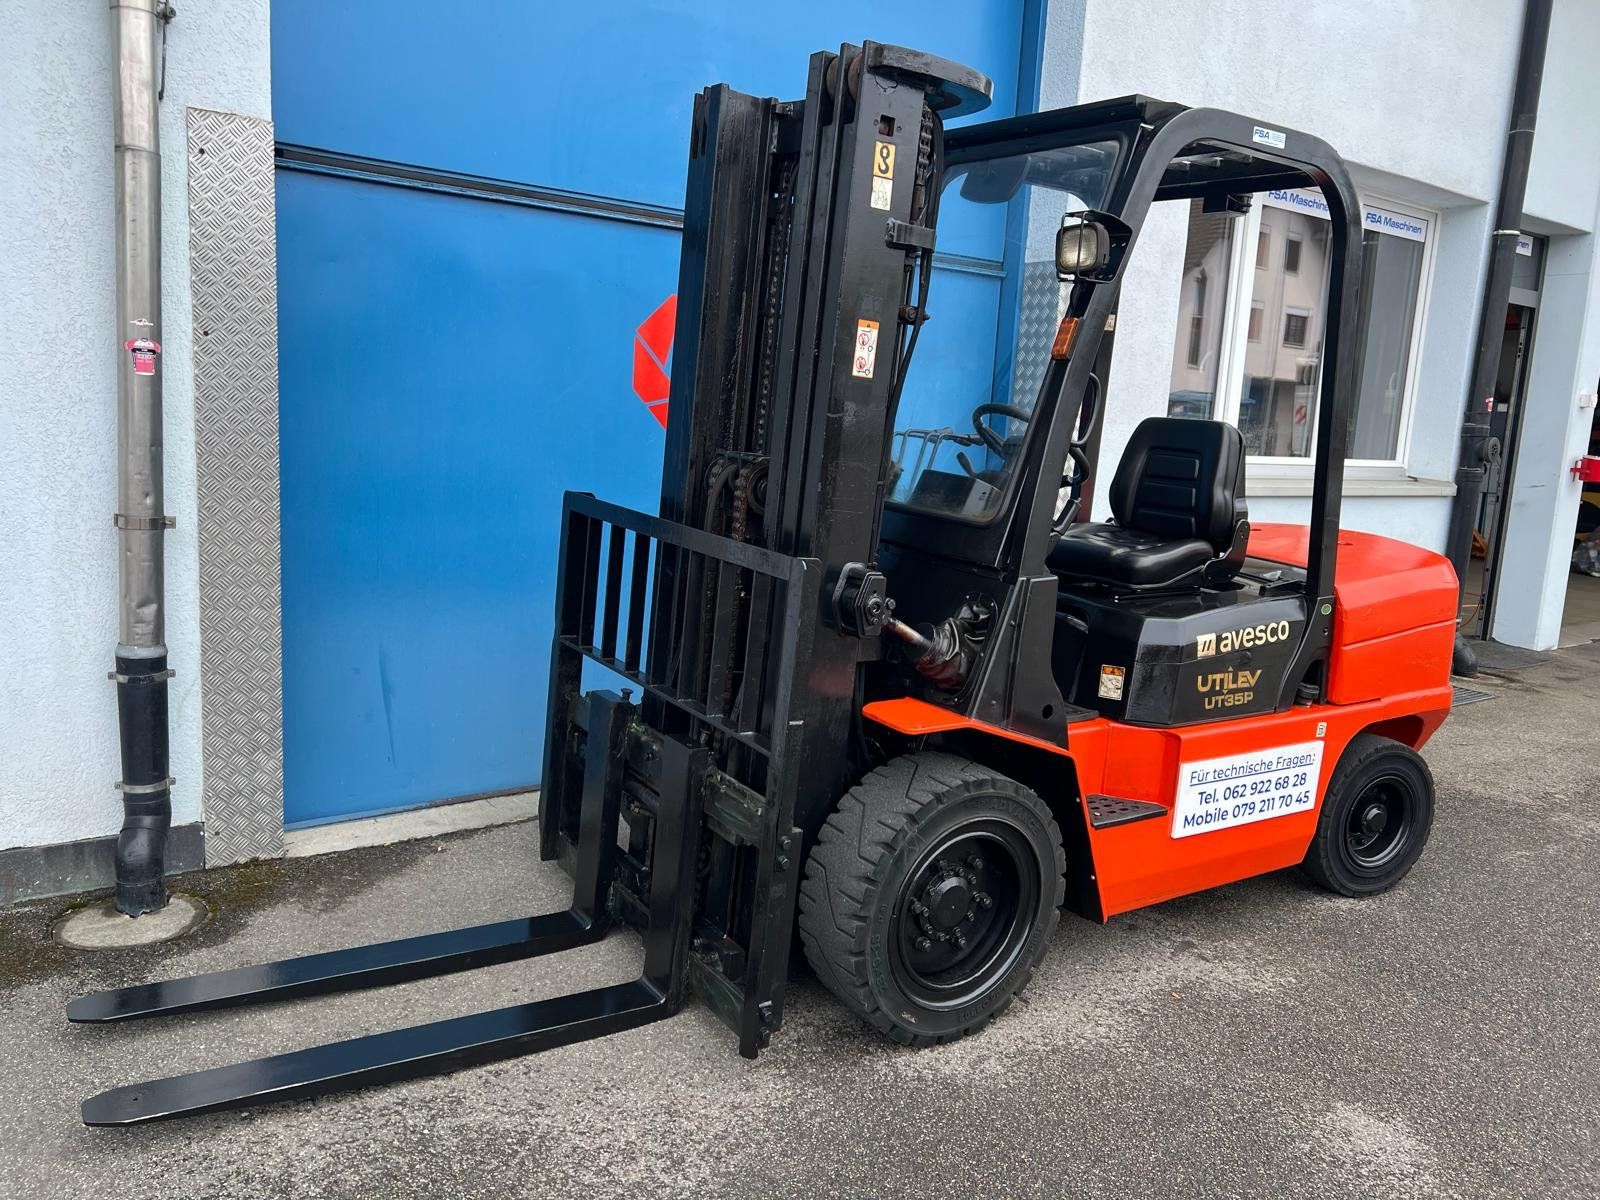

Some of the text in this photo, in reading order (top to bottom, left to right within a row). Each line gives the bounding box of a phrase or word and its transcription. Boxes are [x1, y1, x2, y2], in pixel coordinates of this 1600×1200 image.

[1254, 129, 1270, 139] FSA
[1268, 191, 1329, 212] FSA Maschine
[1366, 212, 1422, 234] FSA Maschinen
[1220, 620, 1289, 653] avesco
[1197, 667, 1262, 692] UTILEV
[1205, 691, 1254, 710] UT35P
[1190, 753, 1316, 784] Für technische Fragen:
[1198, 772, 1307, 806] Tel. 062 922 68 28
[1183, 790, 1310, 829] Mobile 079 211 70 45
